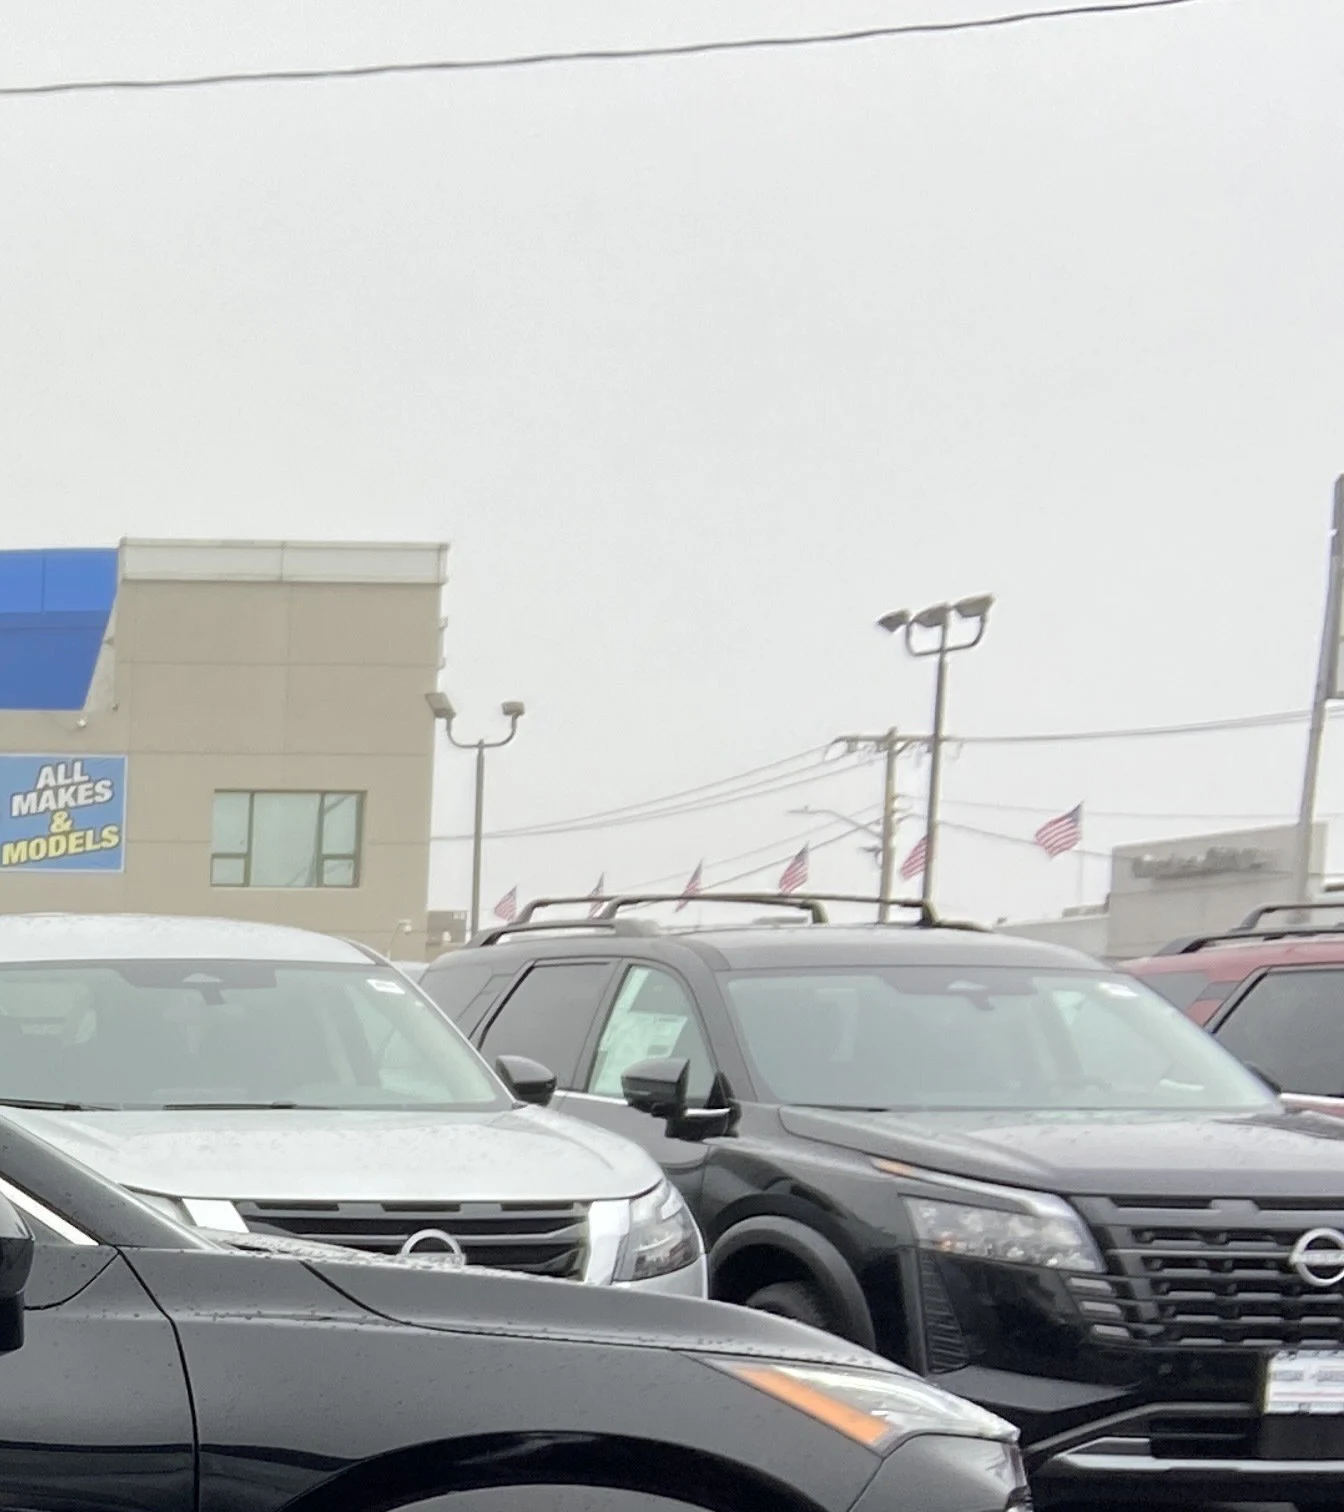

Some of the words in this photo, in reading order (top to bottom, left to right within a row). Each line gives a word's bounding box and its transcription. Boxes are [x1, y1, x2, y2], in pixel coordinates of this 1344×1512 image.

[35, 761, 89, 790] ALL
[11, 779, 113, 818] MAKES
[49, 810, 74, 834] &
[1, 825, 120, 866] MODELS
